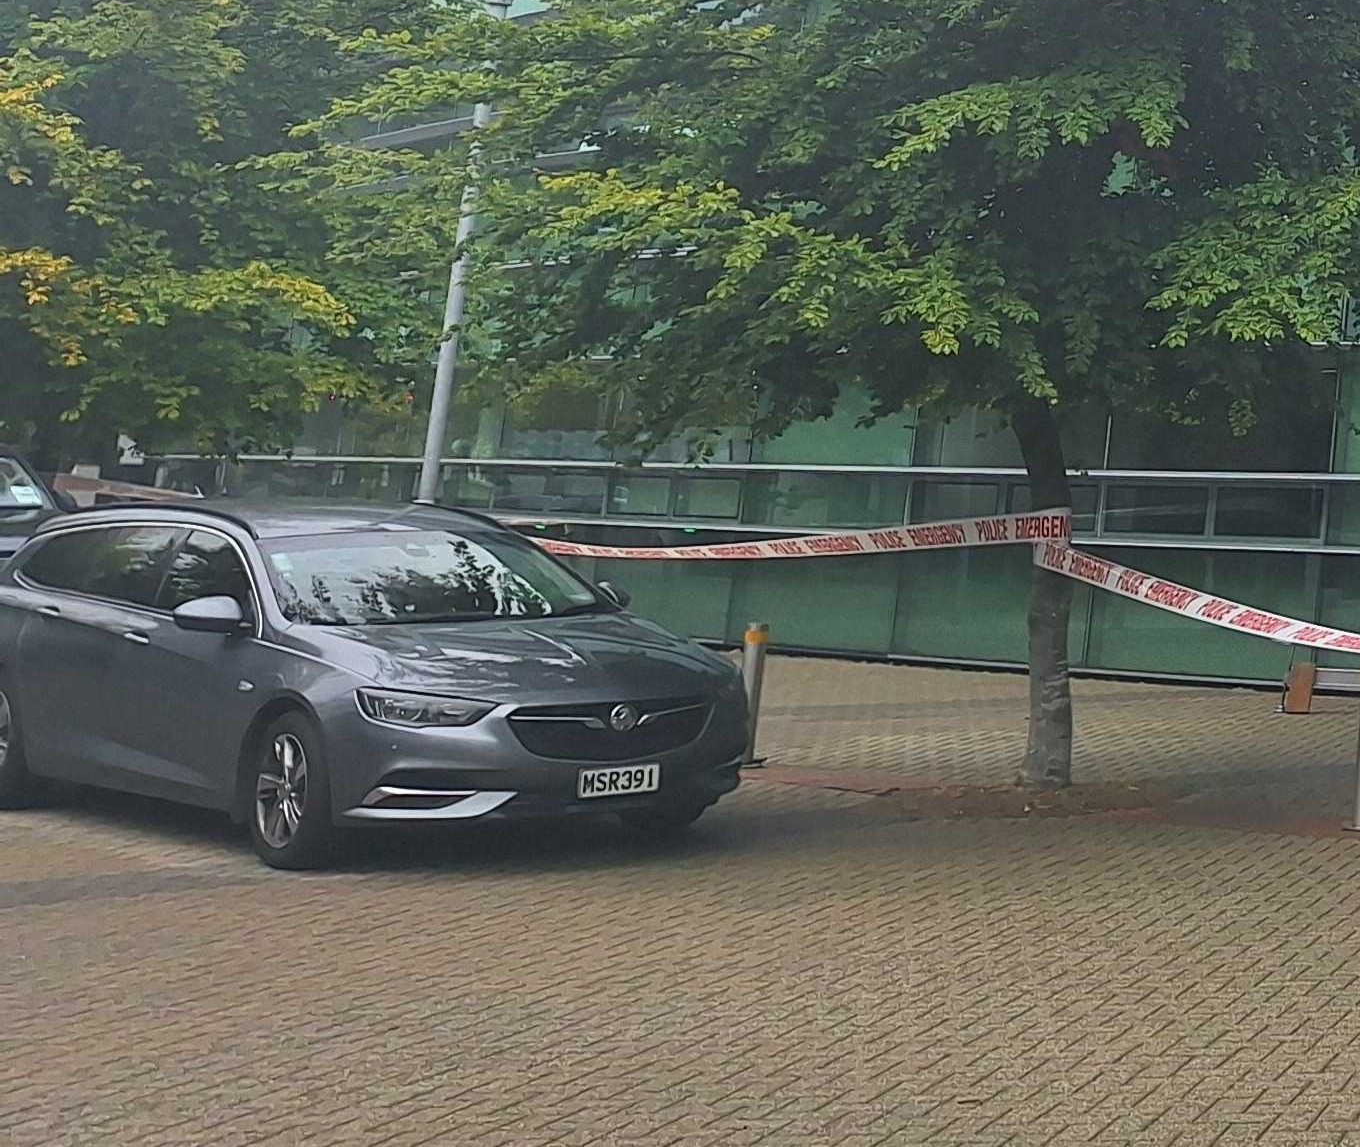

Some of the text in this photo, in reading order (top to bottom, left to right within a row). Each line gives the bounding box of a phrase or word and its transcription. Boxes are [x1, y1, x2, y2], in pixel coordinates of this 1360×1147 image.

[868, 530, 906, 550] POLICE
[910, 523, 967, 545] EMERGENCY
[975, 517, 1009, 542] POLICE
[1015, 515, 1070, 540] EMERGEN
[582, 768, 653, 794] MSR391
